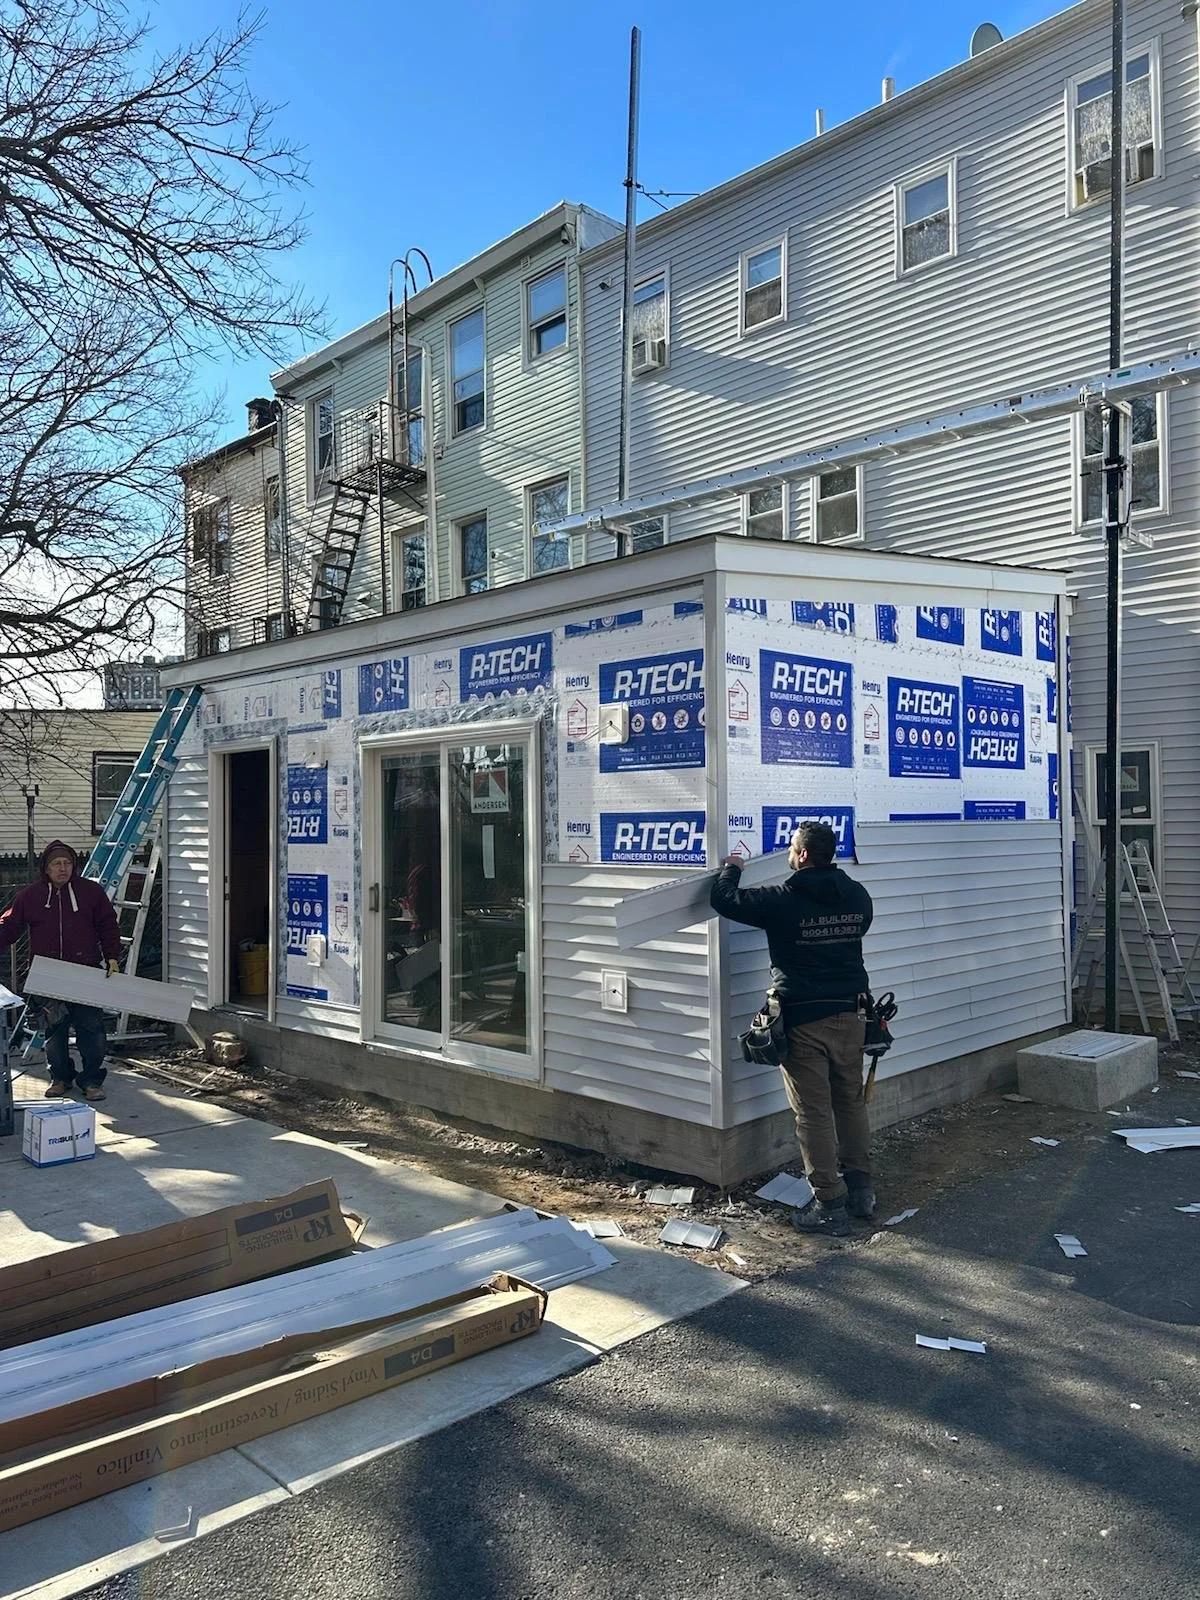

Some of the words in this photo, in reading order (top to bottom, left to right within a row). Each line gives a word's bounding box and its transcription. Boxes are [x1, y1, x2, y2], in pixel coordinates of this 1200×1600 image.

[470, 643, 543, 680] R-TECH
[726, 651, 750, 669] Henry
[468, 677, 500, 689] ENGINEERED
[499, 675, 511, 683] FOR
[511, 671, 541, 682] EFFICIENCY
[566, 675, 590, 688] Henry
[613, 660, 706, 700] R-TECH
[772, 661, 844, 697] R-TECH
[862, 680, 881, 695] Henry
[652, 696, 666, 705] FOR
[667, 691, 705, 704] EFFICIENC
[770, 691, 804, 702] ENGINEERED
[804, 695, 816, 703] FOR
[816, 697, 843, 706] EFFICIENCY
[897, 686, 953, 717] R-TECH
[970, 737, 1018, 762] R-TECH
[473, 800, 507, 810] ANDERSEN
[288, 816, 321, 837] R-TEC
[566, 821, 591, 834] Henry
[728, 814, 753, 828] Henry
[614, 821, 706, 851] R-TECH
[612, 853, 653, 861] ENGINEERED
[653, 853, 668, 861] FOR
[669, 853, 706, 862] EFFICIENC
[275, 1208, 293, 1223] D4
[238, 1225, 293, 1248] PRODUCTS
[303, 1215, 336, 1243] KP
[246, 1233, 293, 1254] BUILDING
[510, 1307, 537, 1334] KP
[410, 1346, 433, 1366] D4
[343, 1365, 379, 1394] Vinyl
[294, 1382, 340, 1405] Siding
[169, 1405, 279, 1450] Revestimiento
